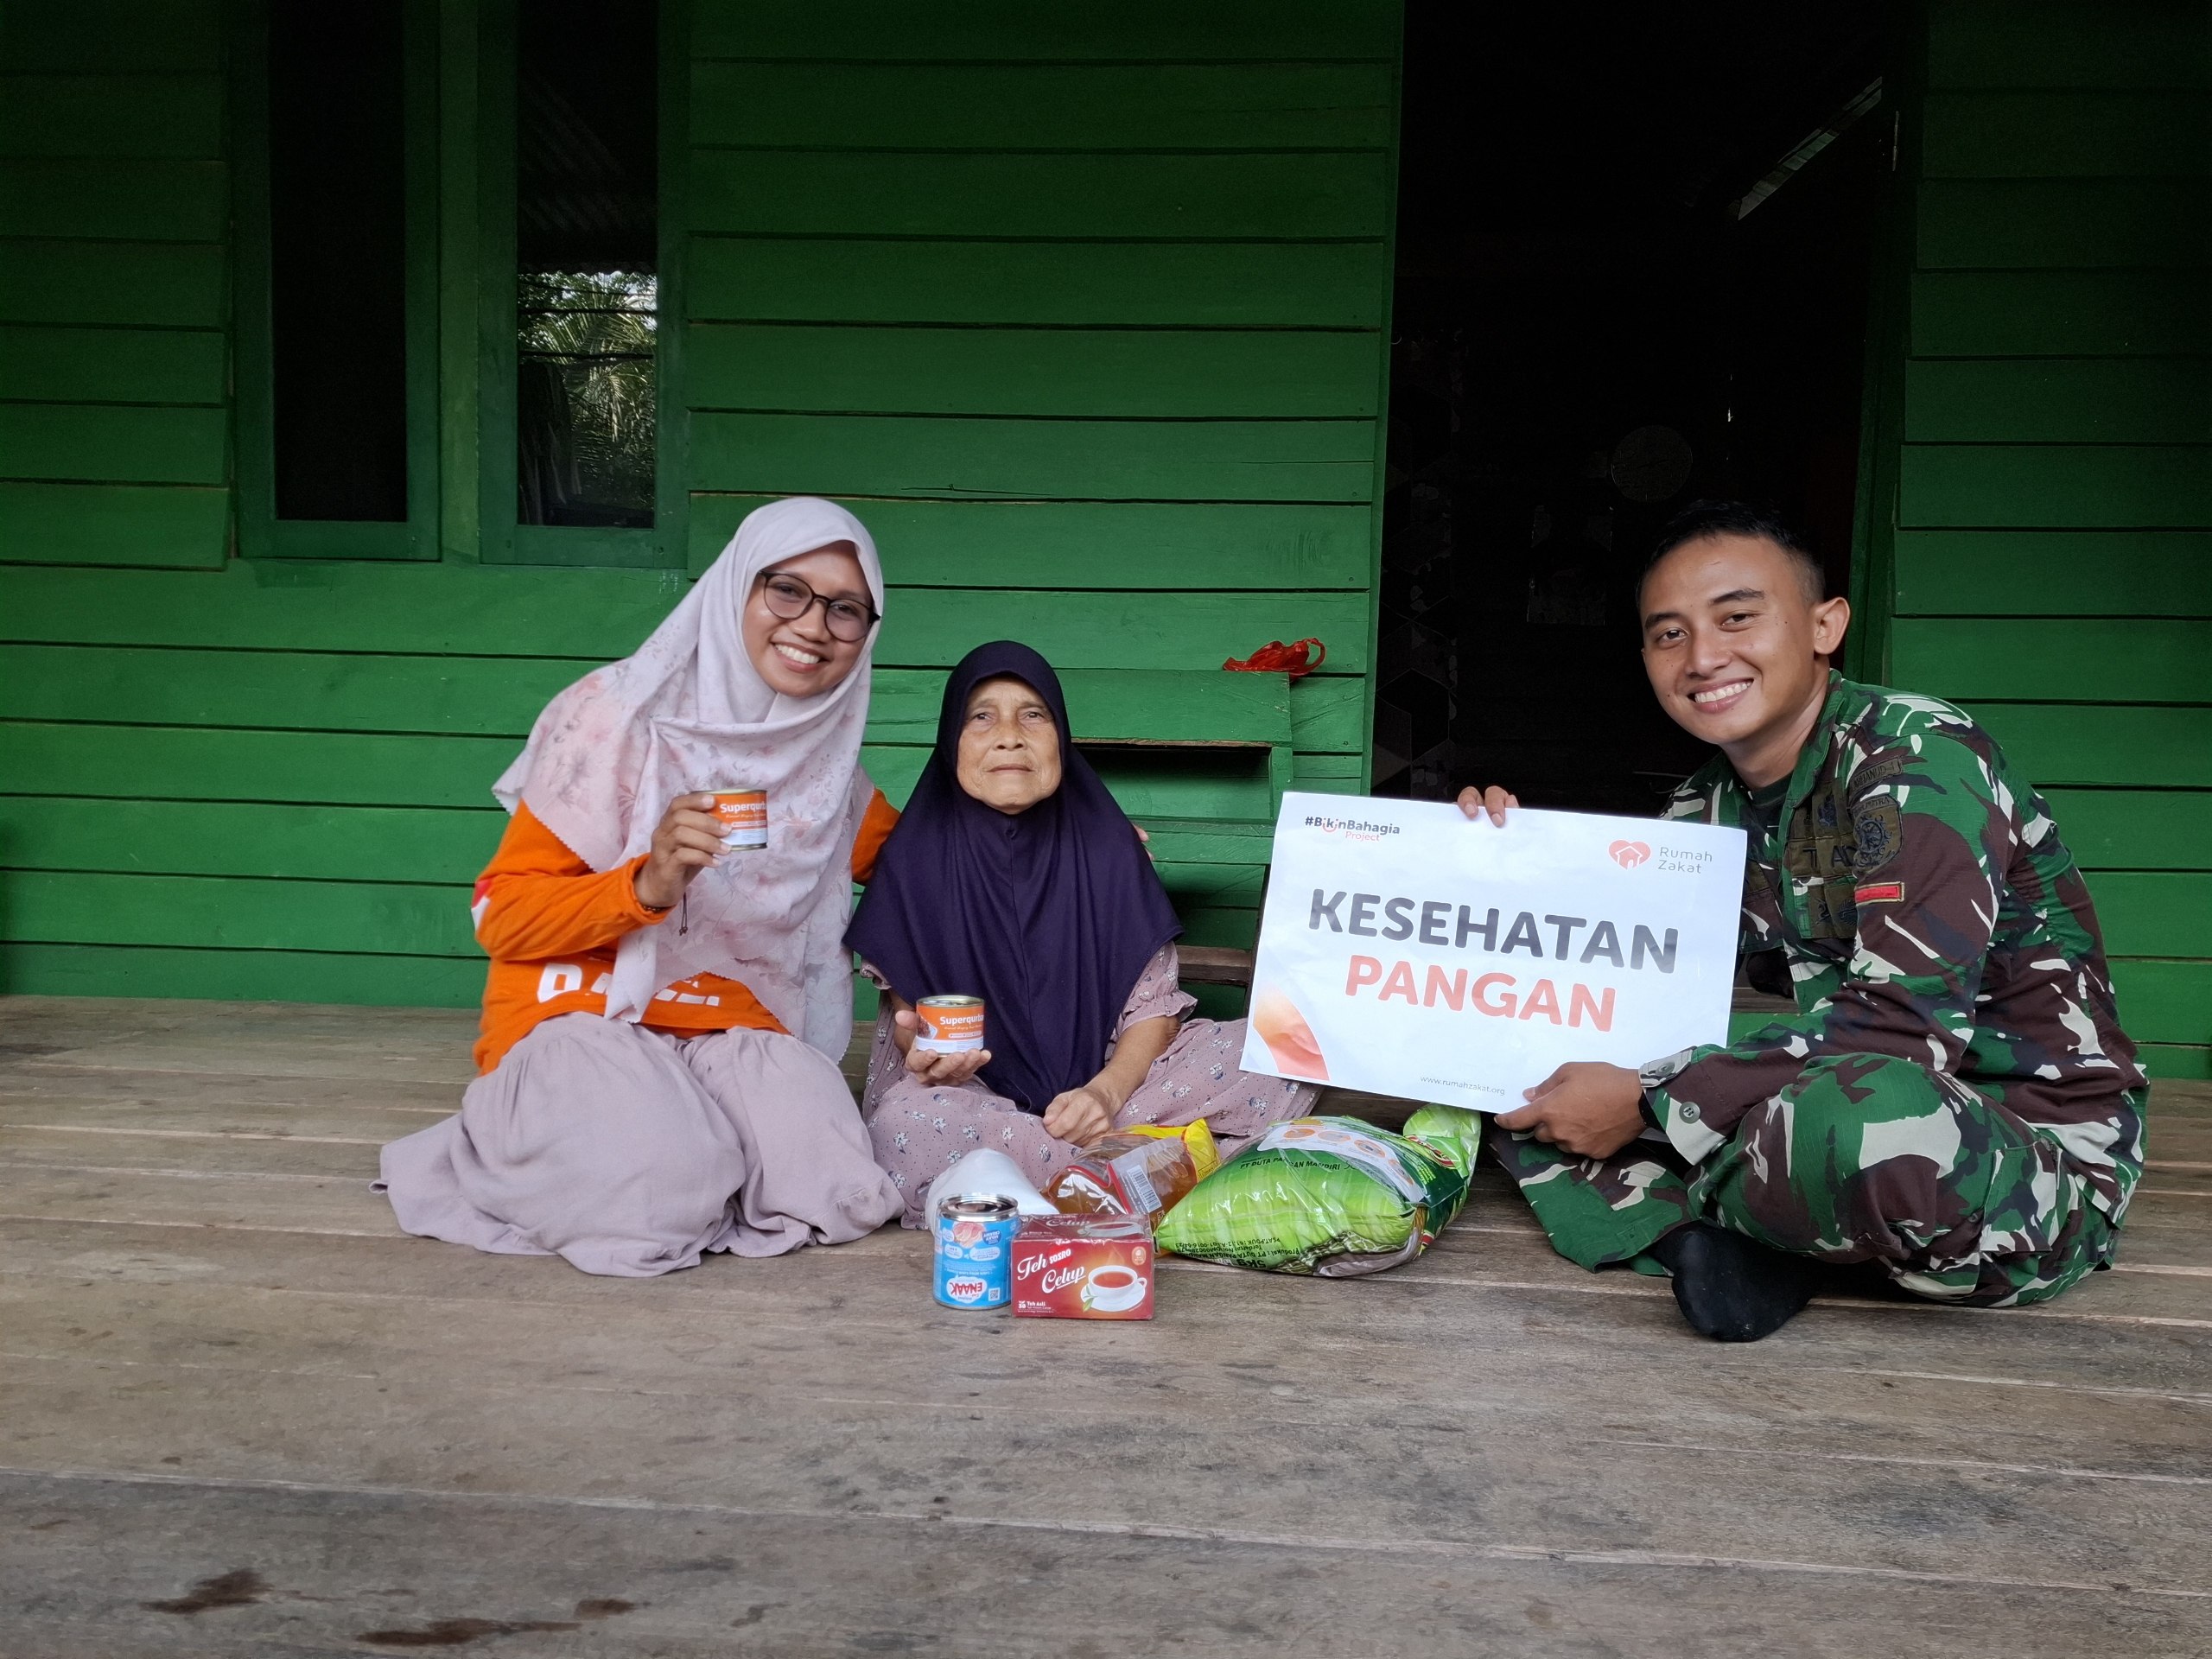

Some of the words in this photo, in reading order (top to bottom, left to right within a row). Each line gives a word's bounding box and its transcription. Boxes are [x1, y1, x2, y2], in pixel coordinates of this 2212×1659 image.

[1305, 817, 1400, 836] #BikinBahagia
[1345, 830, 1380, 842] Project
[1660, 847, 1713, 862] Rumah
[1658, 860, 1702, 874] Zakat
[1308, 888, 1679, 974] KESEHATAN
[1344, 955, 1617, 1033] PANGAN
[1420, 1076, 1505, 1096] www.rumahzakat.org
[1274, 1157, 1304, 1168] PAGAN
[1306, 1160, 1341, 1171] MANDIRI
[1017, 1253, 1047, 1281] Teh
[1049, 1248, 1071, 1264] SOSRO
[949, 1281, 983, 1295] ENAAK
[1041, 1266, 1085, 1294] Celup
